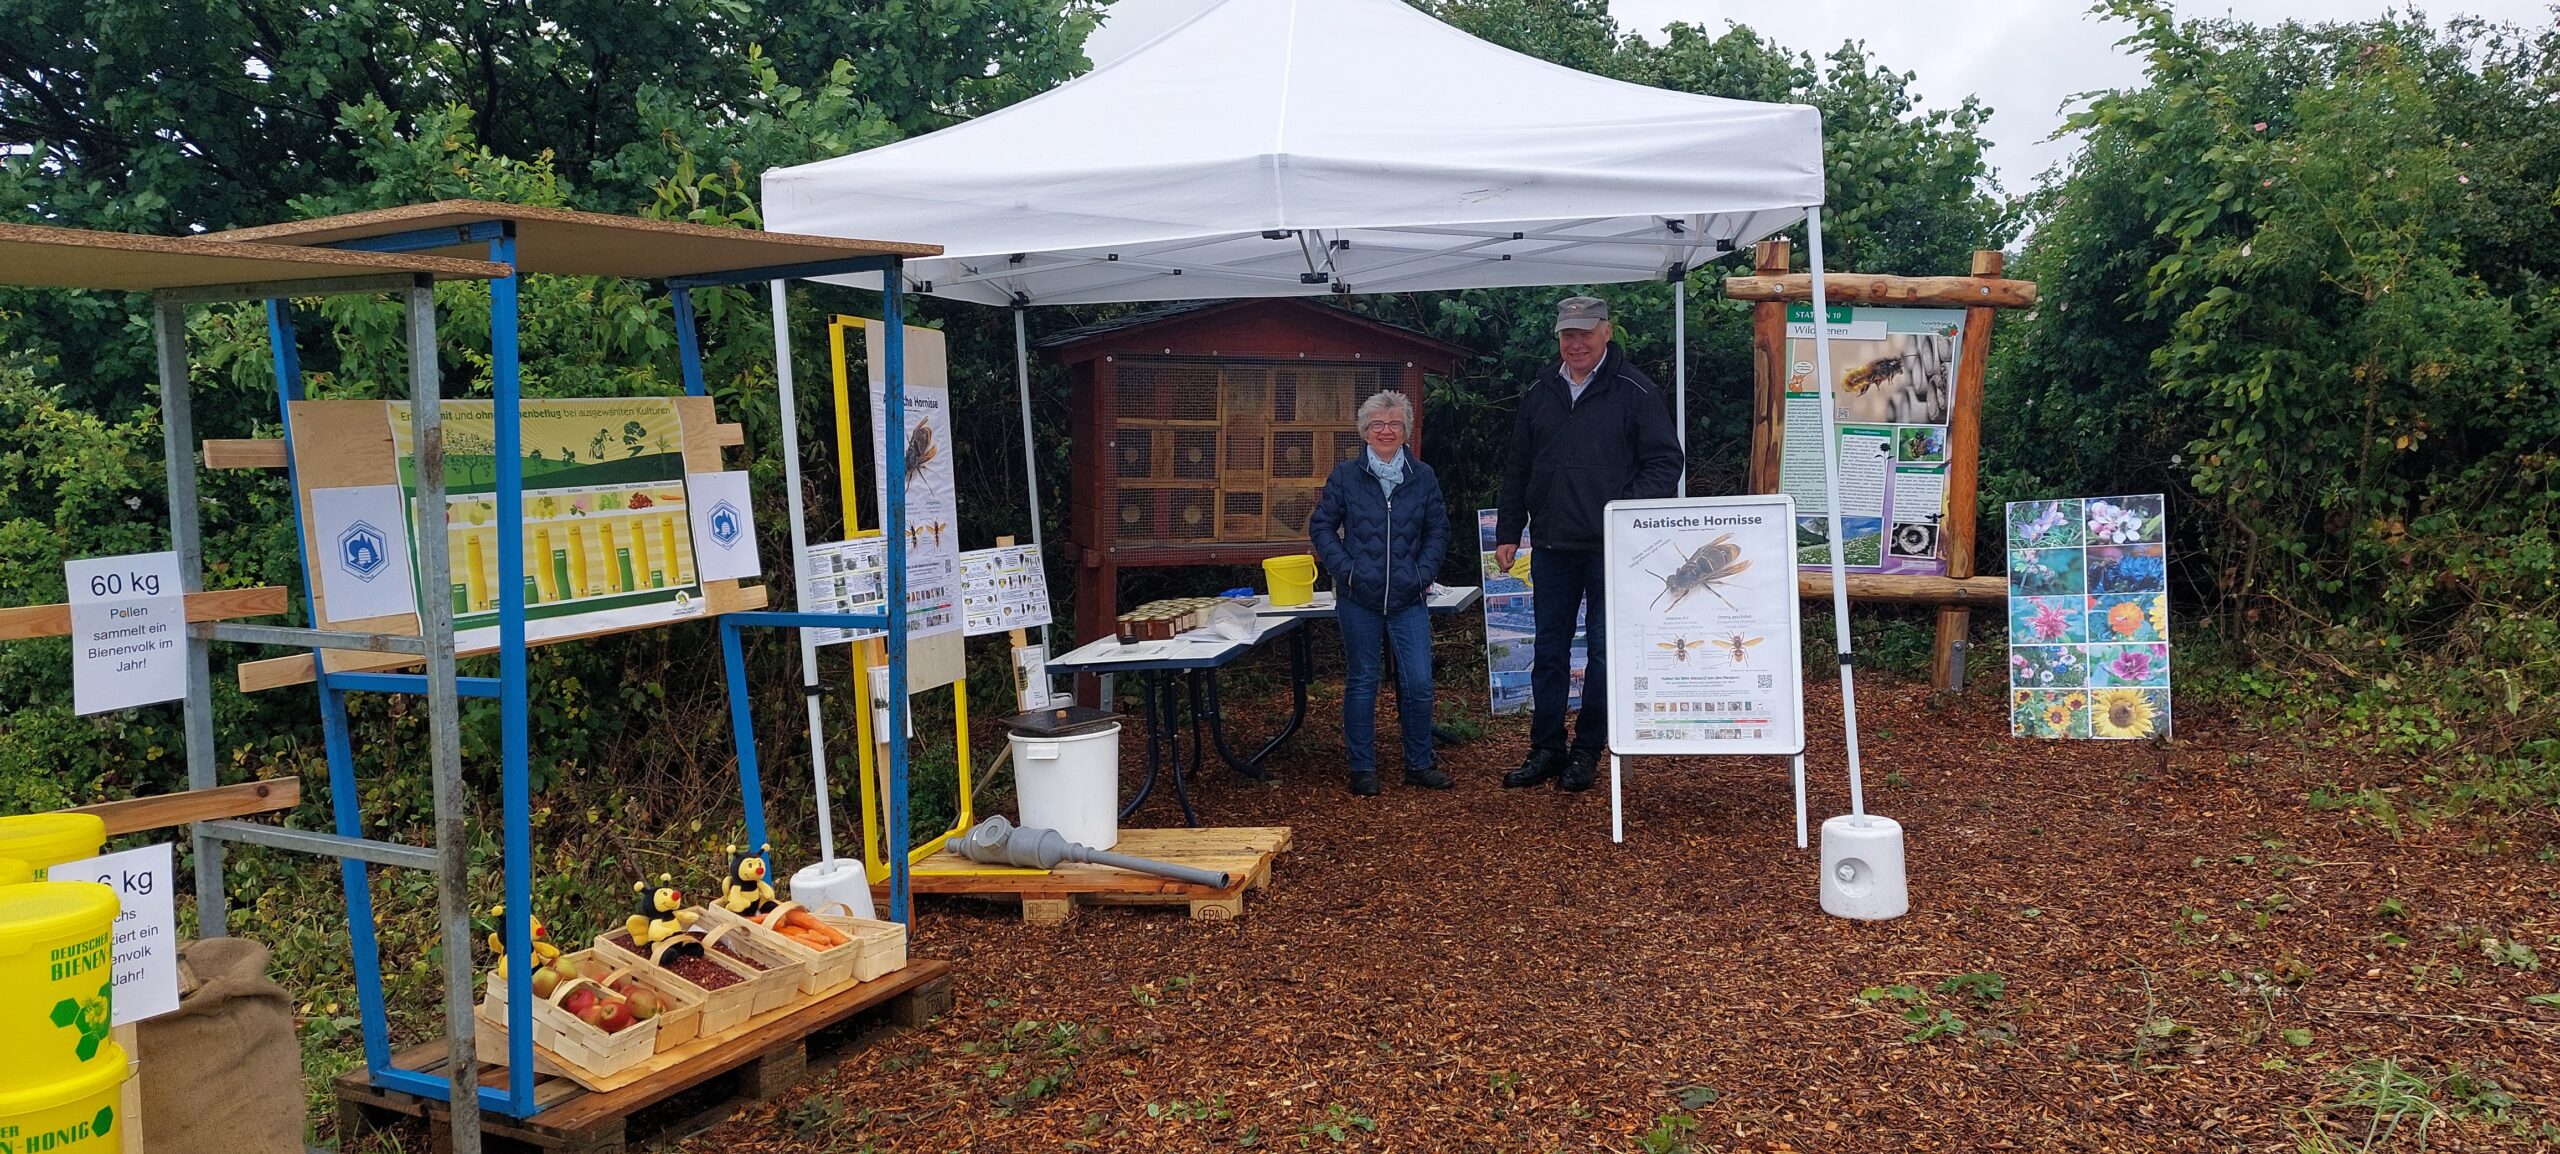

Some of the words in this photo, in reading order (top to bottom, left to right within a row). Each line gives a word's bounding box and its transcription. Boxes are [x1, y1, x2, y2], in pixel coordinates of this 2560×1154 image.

[1795, 311, 1831, 319] STATN
[914, 396, 939, 409] Hornisse
[454, 411, 473, 420] und
[475, 410, 494, 420] ohn
[519, 409, 562, 419] enbeflug
[563, 408, 577, 417] bei
[579, 406, 634, 419] ausgewählten
[635, 406, 671, 415] Kulturen
[1633, 516, 1700, 529] Asiatische
[1704, 514, 1763, 526] Hornisse
[91, 574, 122, 596] 60
[130, 571, 160, 595] kg
[110, 606, 148, 619] Pollen
[93, 625, 146, 641] sammelt
[149, 622, 167, 634] ein
[88, 641, 155, 659] Bienenvolk
[159, 639, 173, 649] im
[116, 658, 147, 672] Jahr!
[123, 870, 153, 895] kg
[114, 910, 137, 923] chs
[1203, 909, 1229, 921] EPAL
[112, 930, 136, 945] ziert
[140, 925, 159, 938] ein
[51, 932, 108, 961] DEUTSCHER
[112, 945, 152, 965] envolk
[51, 948, 112, 981] BIENEN-
[112, 967, 144, 986] Jahr!
[0, 1121, 89, 1154] N-HONIG
